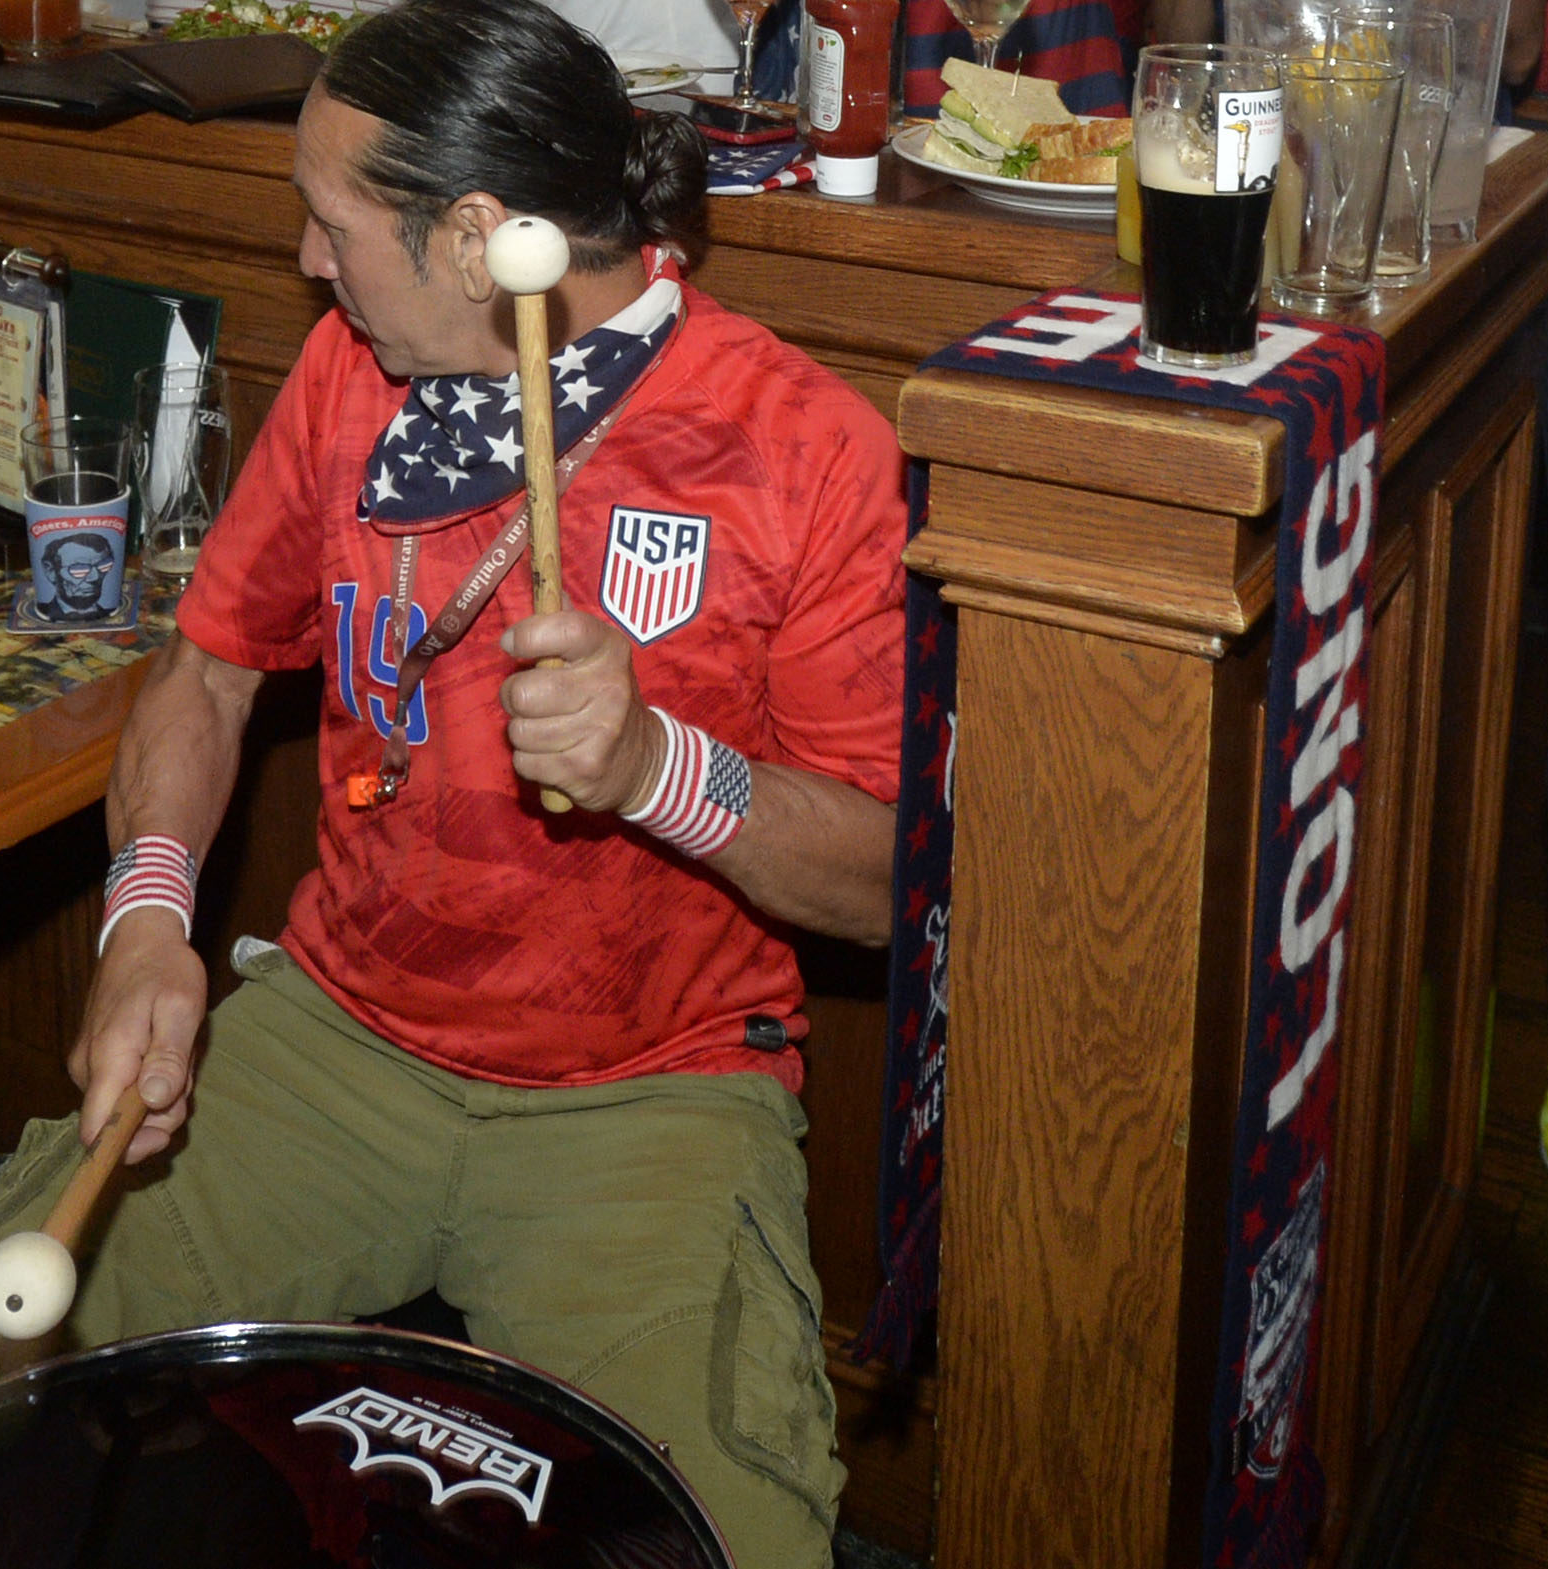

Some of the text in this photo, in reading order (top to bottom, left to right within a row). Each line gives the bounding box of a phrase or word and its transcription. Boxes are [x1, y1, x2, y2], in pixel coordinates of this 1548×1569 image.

[454, 545, 509, 612] Outlaws
[614, 513, 701, 568] USA
[329, 581, 430, 747] 19
[1265, 430, 1377, 1133] LONG
[349, 1398, 535, 1485] REMO
